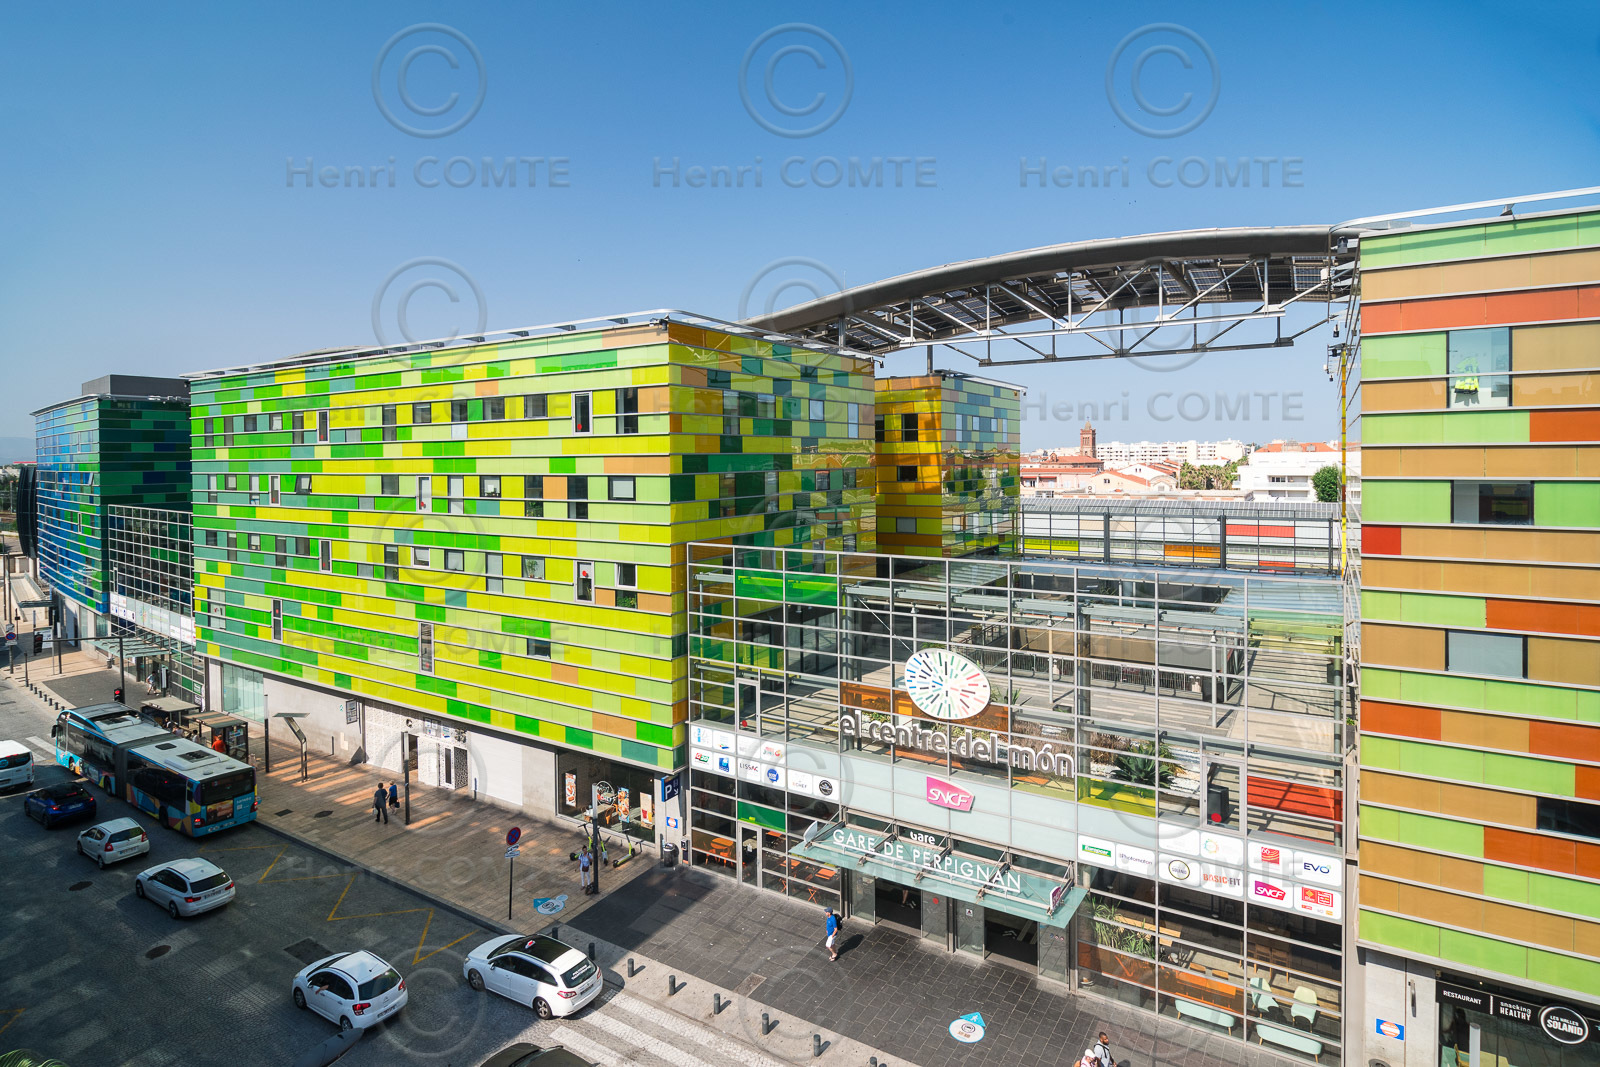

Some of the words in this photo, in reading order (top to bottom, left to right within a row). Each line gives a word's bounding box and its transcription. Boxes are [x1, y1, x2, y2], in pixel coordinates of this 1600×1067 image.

[840, 710, 862, 738] el
[868, 720, 948, 754] centre
[955, 729, 998, 764] del
[1008, 744, 1075, 779] món
[739, 763, 759, 773] LISSAC
[665, 784, 673, 799] P
[928, 788, 970, 806] SNCF
[833, 829, 875, 851] GARE
[884, 842, 904, 860] DE
[913, 849, 1021, 891] PERPIGNAN
[1304, 862, 1330, 874] EVO
[1203, 873, 1241, 886] BASIC-FIT
[1256, 887, 1284, 898] SNCF
[1443, 990, 1482, 1005] RESTAURANT
[1500, 1001, 1532, 1015] snacking
[1500, 1007, 1531, 1021] HEALTHY
[1546, 1019, 1584, 1036] SOLANID
